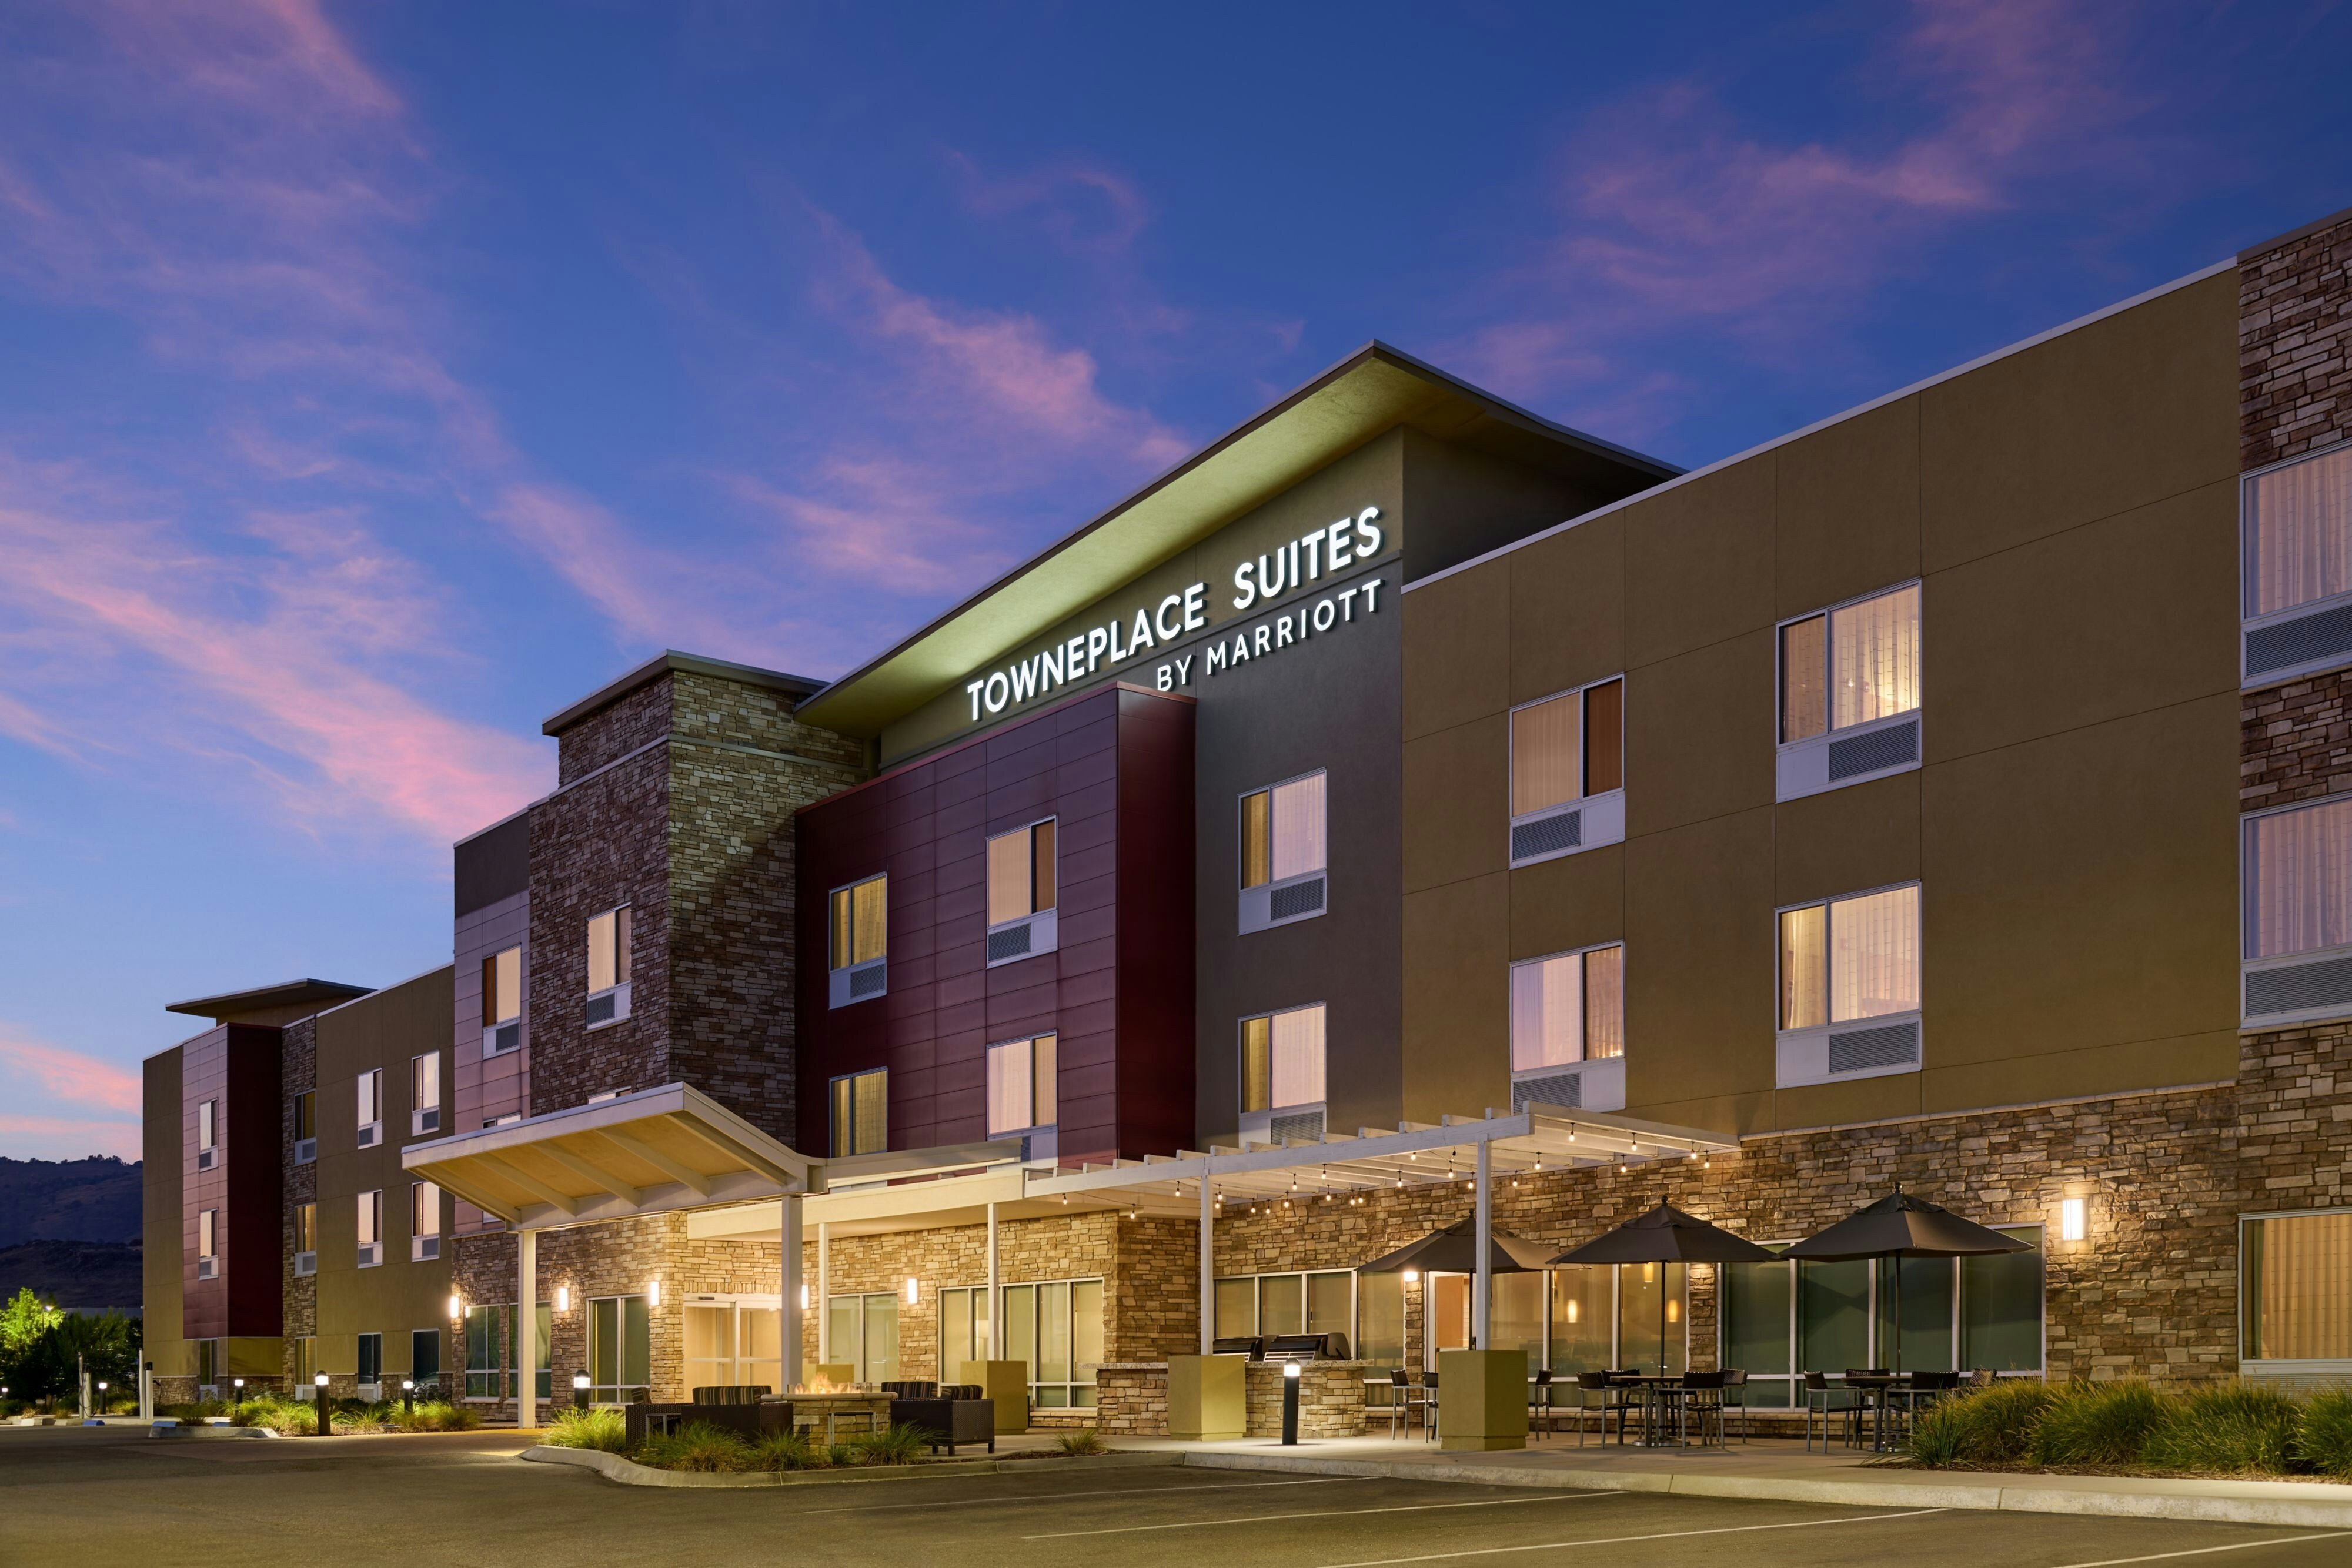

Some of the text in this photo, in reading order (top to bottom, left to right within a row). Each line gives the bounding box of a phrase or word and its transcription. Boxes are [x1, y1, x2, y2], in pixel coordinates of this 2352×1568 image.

[967, 506, 1382, 721] TOWNEPLACE SUITES
[1157, 578, 1383, 693] BY MARRIOTT
